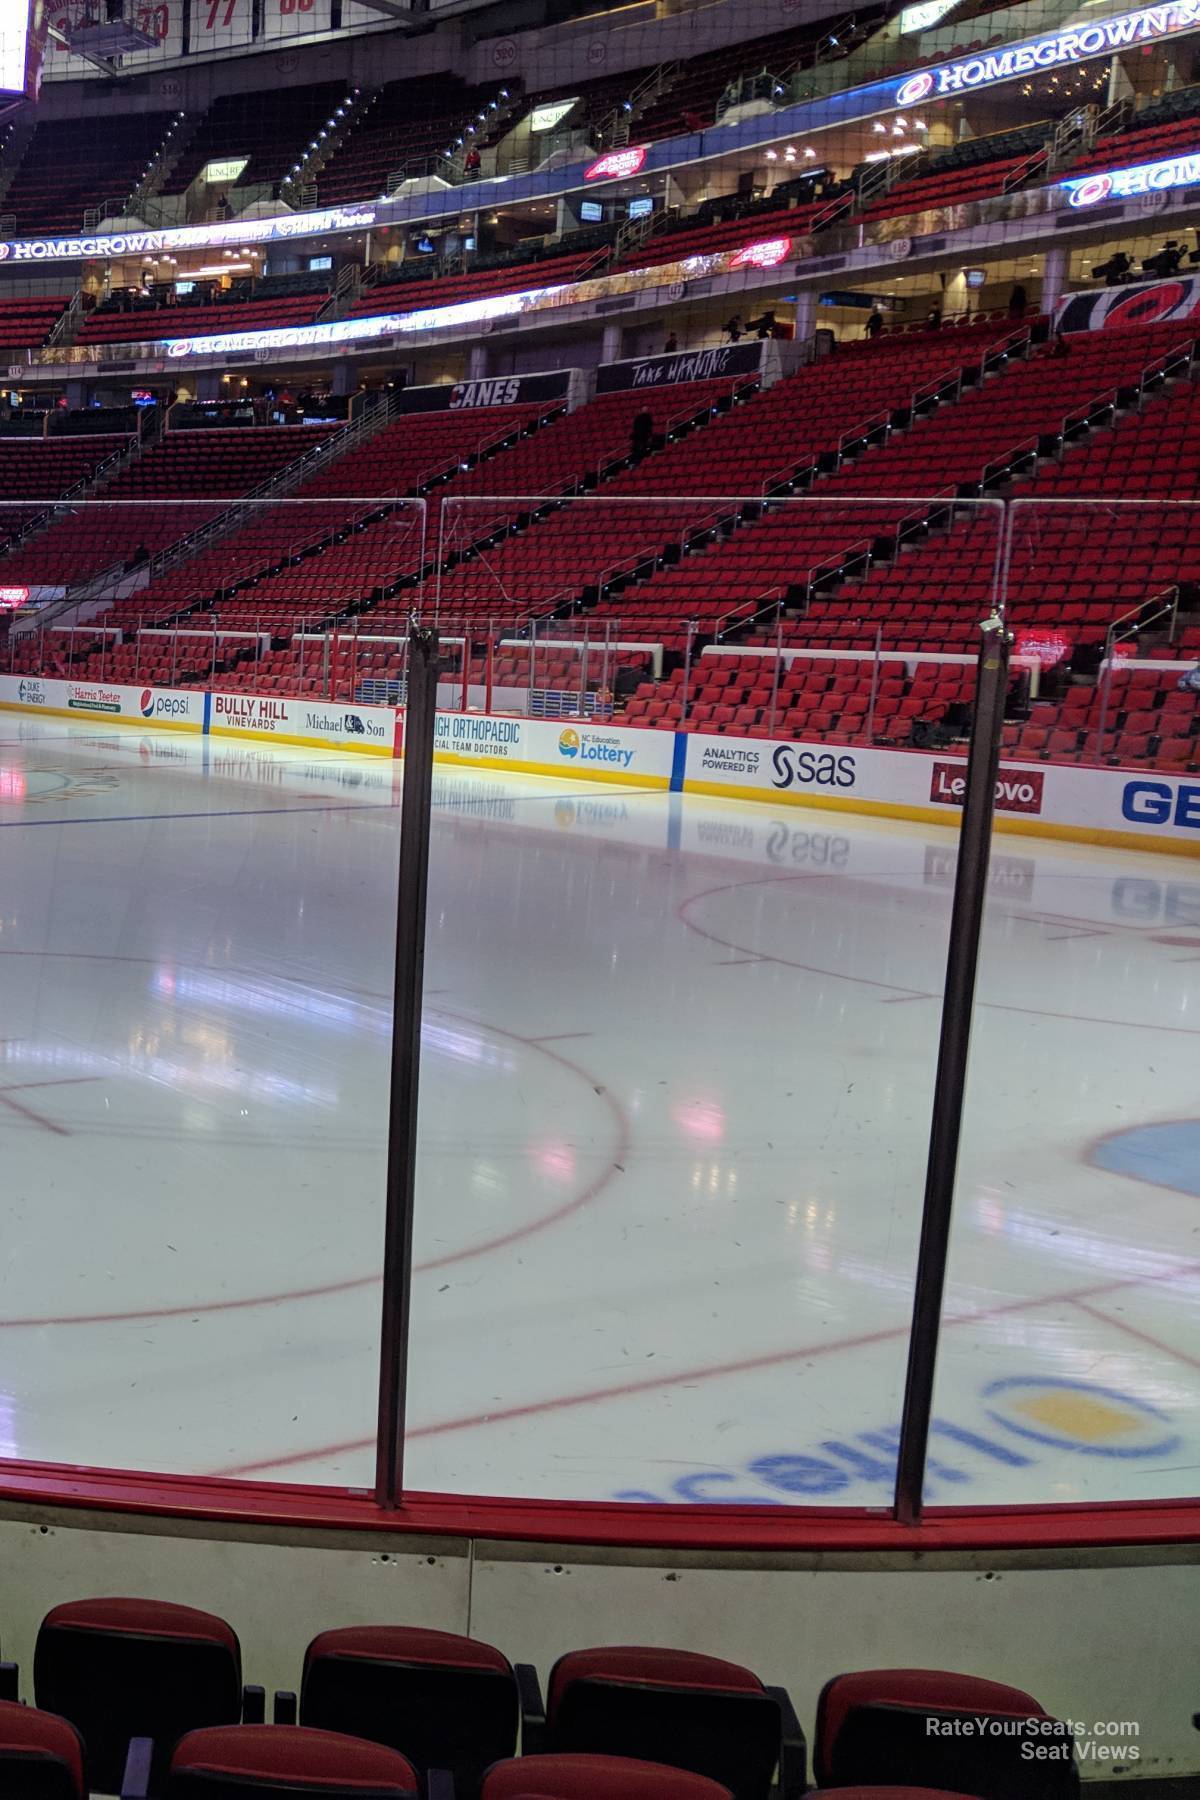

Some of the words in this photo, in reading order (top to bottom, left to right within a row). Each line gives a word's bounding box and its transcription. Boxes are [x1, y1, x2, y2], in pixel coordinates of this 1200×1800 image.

[937, 9, 1173, 93] HOMEGROWN
[14, 233, 164, 259] HOMEGROWN
[450, 380, 520, 409] CANES
[27, 681, 40, 692] DUKE
[27, 692, 46, 704] ENERGY
[75, 687, 97, 699] Harris
[98, 690, 121, 702] Teeter
[156, 696, 190, 718] pepsi
[215, 697, 255, 717] BULLY
[259, 701, 288, 720] HILL
[227, 715, 275, 730] VINEYARDS
[305, 714, 343, 731] Michael
[366, 723, 385, 737] Son
[453, 719, 521, 743] ORTHOPAEDIC
[452, 741, 471, 752] TEAM
[474, 743, 508, 756] DOCTORS
[581, 743, 634, 768] Lottery
[704, 748, 760, 763] ANALYTICS
[702, 759, 745, 773] POWERED
[747, 764, 760, 774] BY
[797, 751, 856, 787] sas
[939, 772, 1034, 802] Leovo
